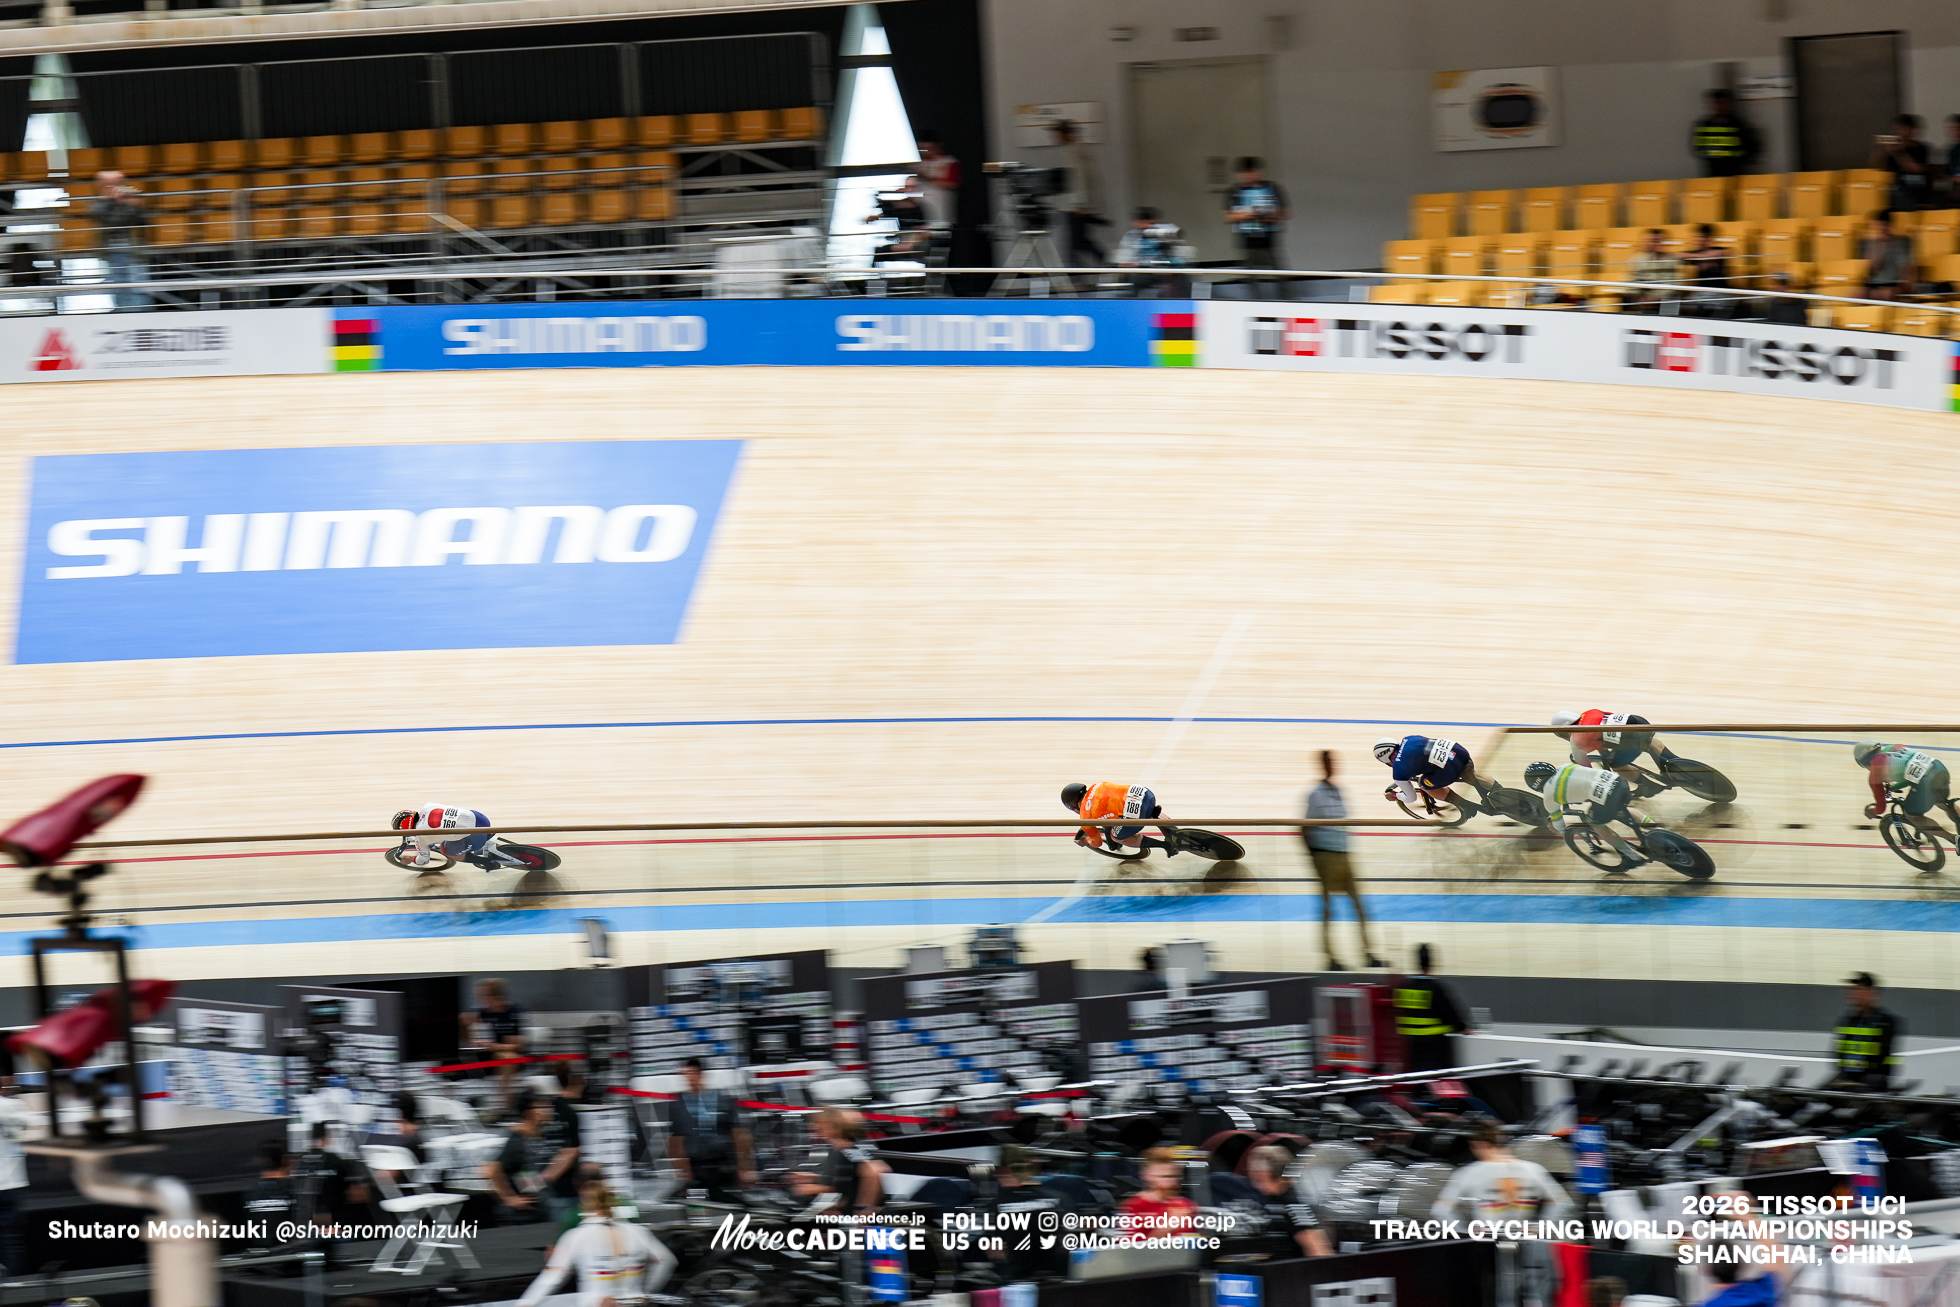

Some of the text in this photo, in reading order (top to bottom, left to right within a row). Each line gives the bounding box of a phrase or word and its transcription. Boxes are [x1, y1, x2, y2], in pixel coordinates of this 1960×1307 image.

[441, 316, 708, 355] SHIMANO
[835, 315, 1096, 352] SHIMANO
[1334, 319, 1528, 363] TISSOT
[1707, 335, 1902, 388] TISSOT
[46, 504, 698, 579] SHIMANO
[1432, 748, 1447, 763] 113
[442, 818, 457, 829] 168
[1126, 801, 1140, 815] 188
